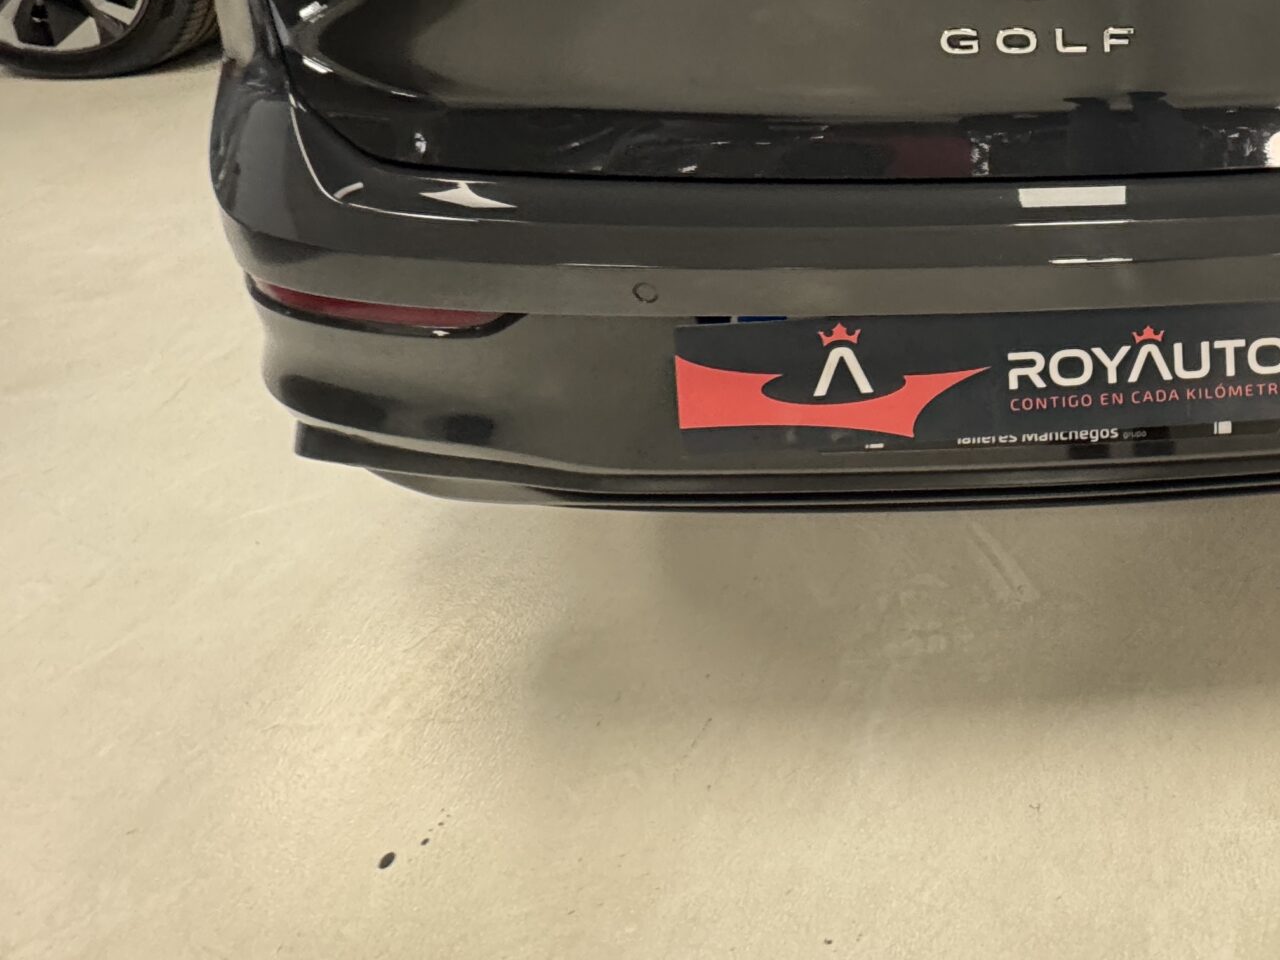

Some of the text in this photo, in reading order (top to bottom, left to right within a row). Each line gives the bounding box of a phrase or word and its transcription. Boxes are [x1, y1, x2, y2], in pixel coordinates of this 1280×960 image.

[940, 27, 1134, 54] GOLF
[1010, 394, 1092, 412] CONTIGO
[1100, 392, 1125, 406] EN
[1131, 389, 1180, 405] CADA
